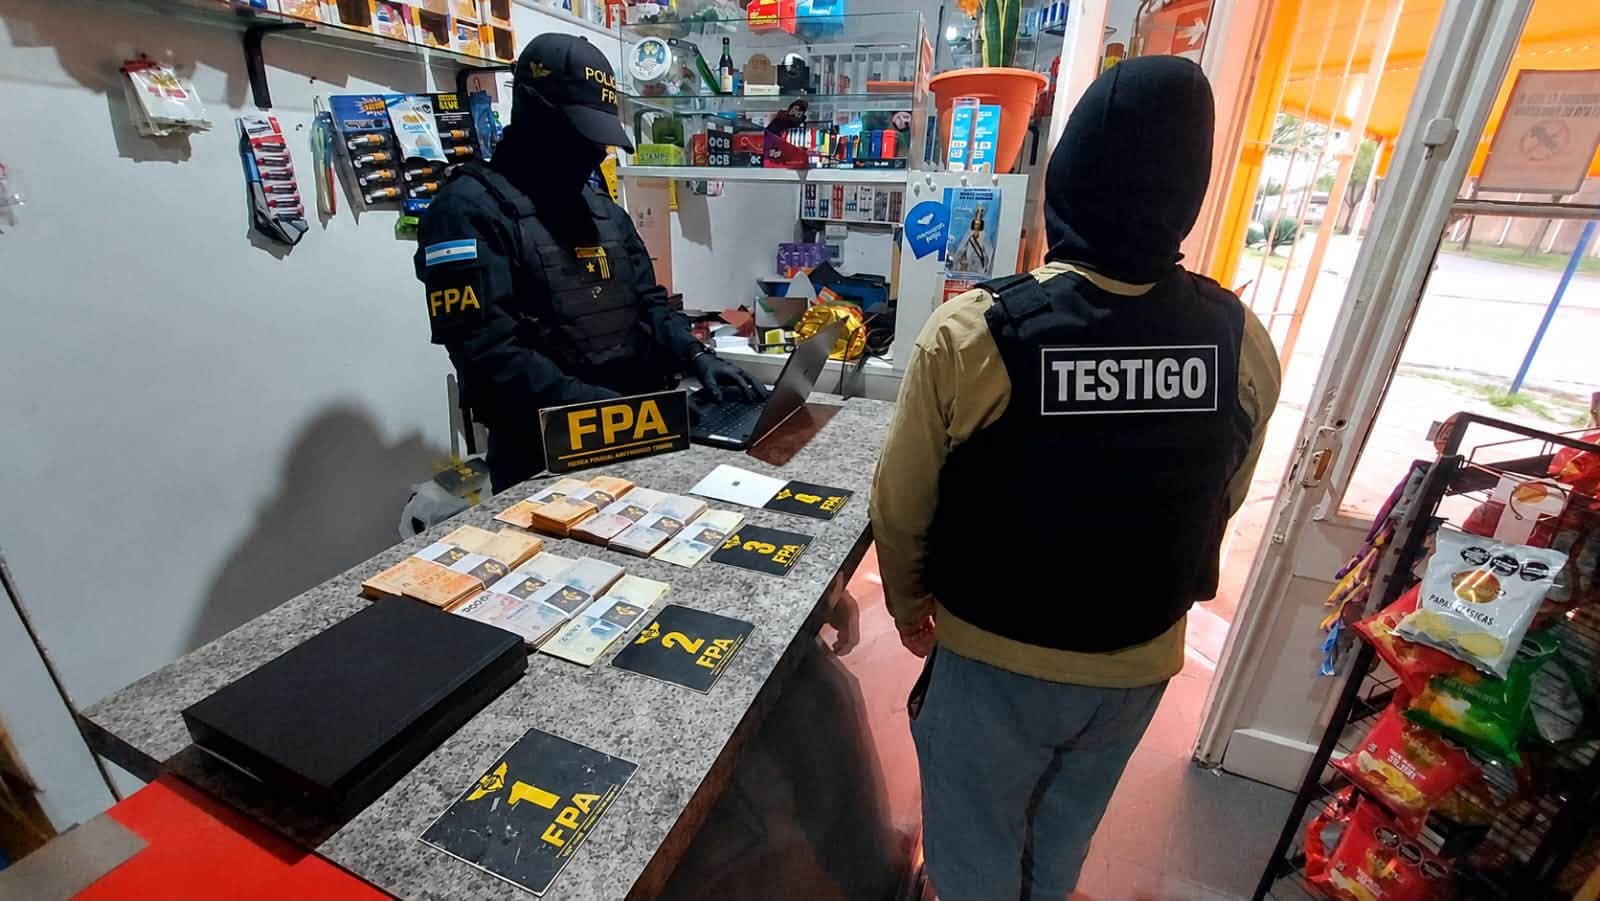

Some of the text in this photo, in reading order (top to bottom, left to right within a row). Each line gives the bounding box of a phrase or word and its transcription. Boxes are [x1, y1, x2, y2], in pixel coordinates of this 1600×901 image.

[709, 136, 730, 148] OCB
[709, 154, 730, 165] OCB
[430, 284, 481, 317] FPA
[1051, 357, 1207, 401] TESTIGO
[567, 400, 669, 450] FPA
[819, 496, 842, 511] FPA
[742, 540, 777, 555] 3
[771, 544, 800, 564] FPA
[1455, 604, 1495, 626] CSICAS
[661, 631, 705, 655] 2
[695, 638, 734, 669] FPA
[507, 780, 561, 810] 1
[540, 793, 601, 848] FPA
